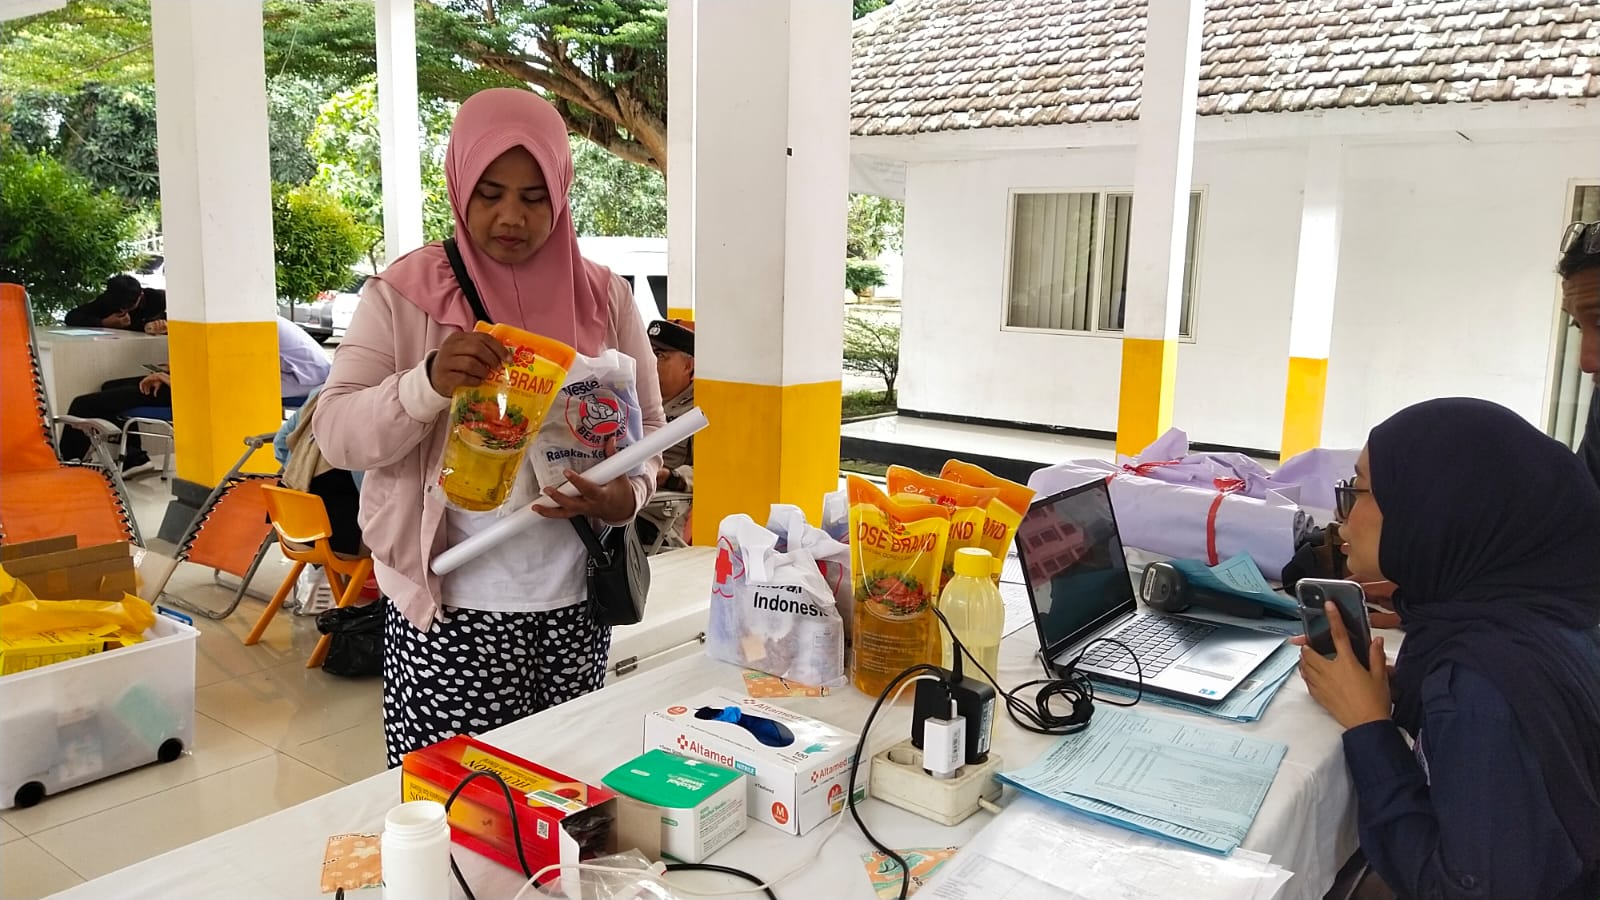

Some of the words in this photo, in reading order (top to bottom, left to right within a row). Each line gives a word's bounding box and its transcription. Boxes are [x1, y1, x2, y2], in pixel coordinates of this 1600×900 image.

[509, 369, 554, 395] BRAND
[577, 426, 602, 444] BEAR
[546, 448, 590, 462] Rasakan
[890, 532, 937, 553] BRAND
[689, 741, 734, 768] Altamed
[820, 757, 848, 779] Altamed
[776, 805, 785, 818] M
